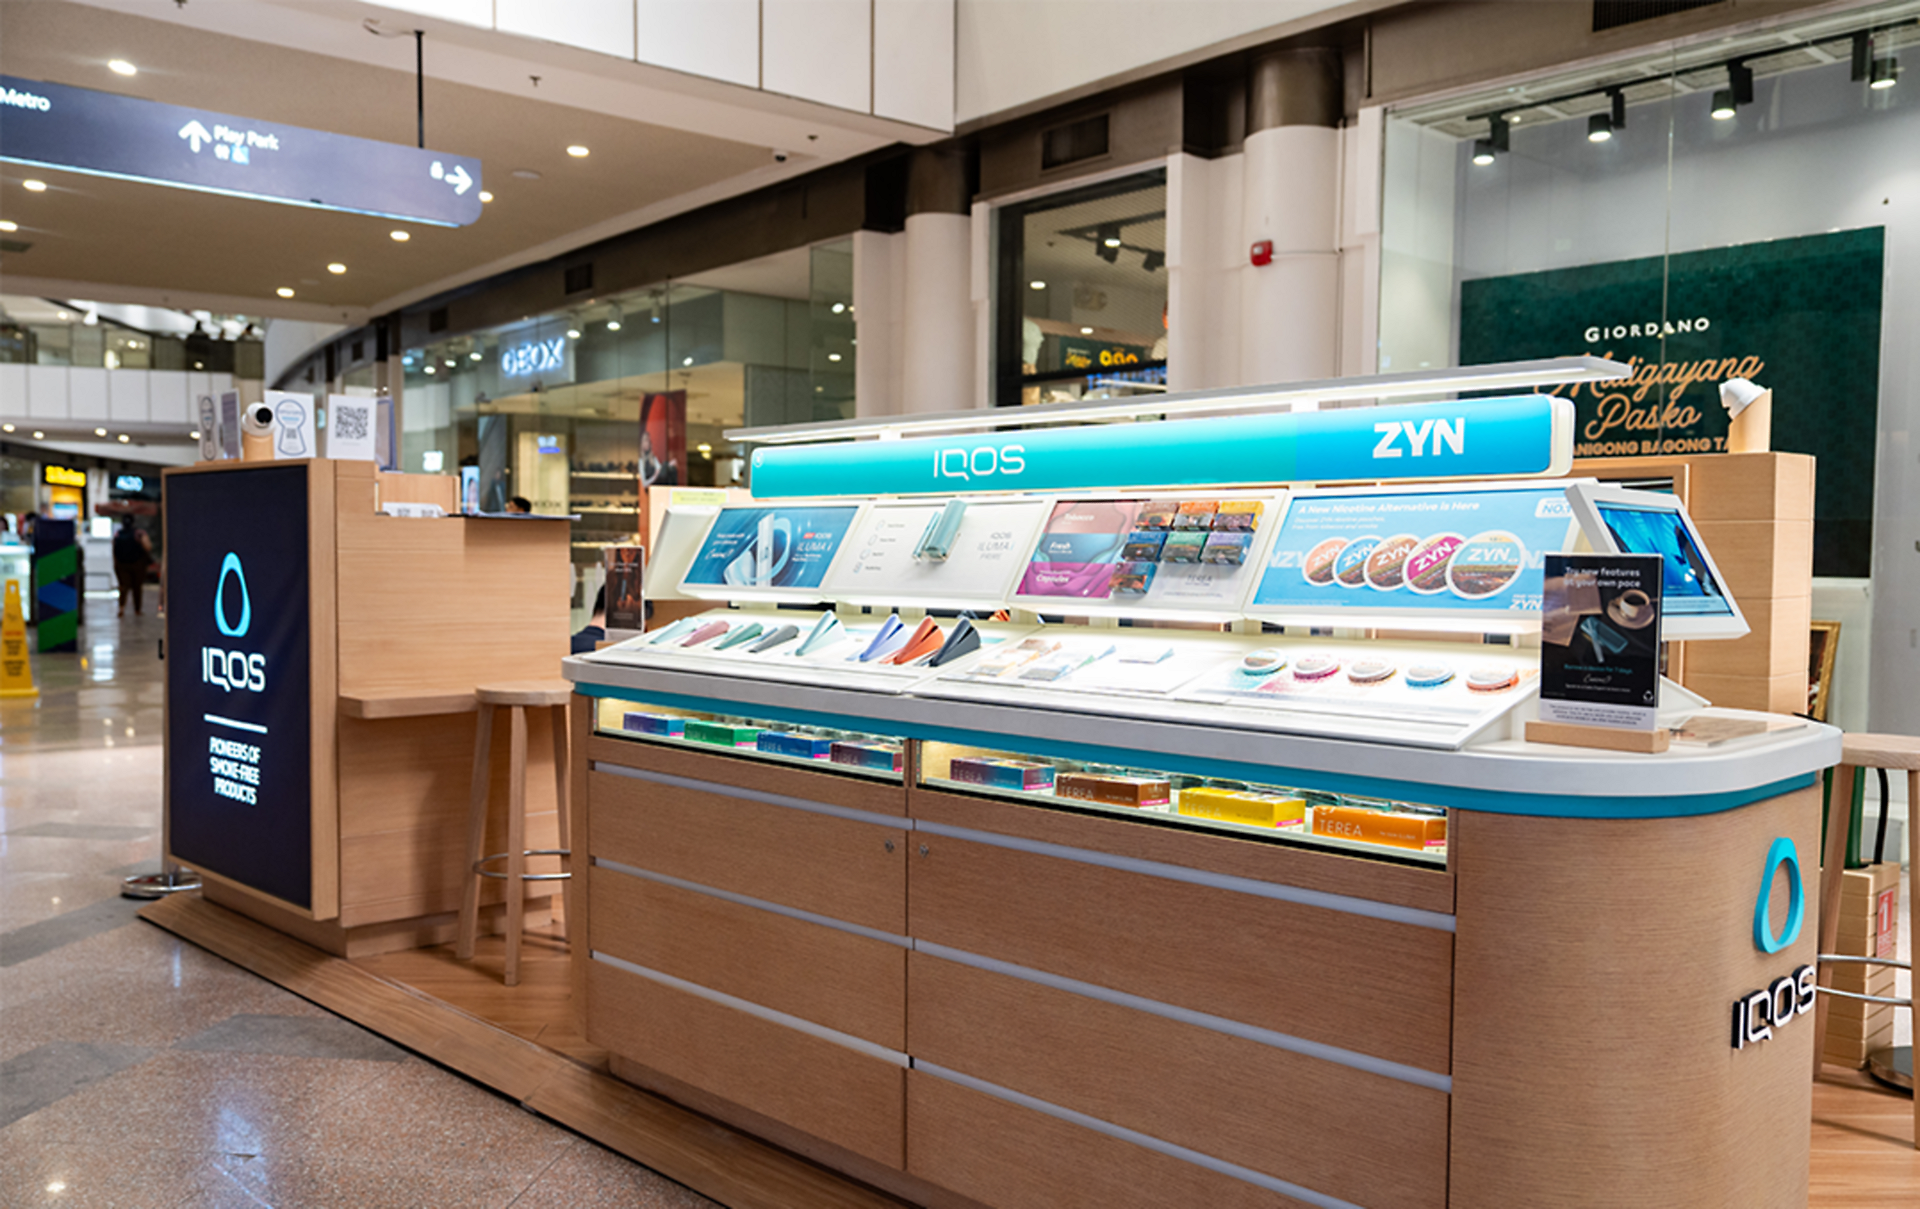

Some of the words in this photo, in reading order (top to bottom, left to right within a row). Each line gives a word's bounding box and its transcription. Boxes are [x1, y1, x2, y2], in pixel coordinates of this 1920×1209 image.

[213, 124, 245, 147] Play
[247, 130, 279, 151] Park
[1584, 317, 1710, 343] GIORDANO
[501, 337, 564, 377] GEOX
[1585, 393, 1703, 440] Pasko
[1373, 417, 1465, 459] ZYN
[1641, 438, 1711, 454] BAGONG
[933, 444, 1026, 482] IQOS
[1308, 506, 1331, 514] New
[1332, 503, 1376, 514] Nicotine
[1377, 501, 1439, 513] Alternative
[1440, 501, 1450, 511] is
[1452, 502, 1480, 511] Here
[1050, 541, 1072, 550] Fresh
[1312, 544, 1340, 567] ZYN
[1342, 543, 1374, 567] ZYN
[1376, 543, 1410, 566] ZYN
[1414, 541, 1453, 571] ZYN
[1466, 547, 1511, 562] ZYN
[1565, 566, 1580, 578] Try
[1581, 568, 1599, 576] new
[1600, 566, 1641, 577] features
[1576, 579, 1597, 588] your
[1617, 580, 1641, 589] pace
[1508, 598, 1542, 611] ZYN
[202, 646, 266, 693] IQOS
[209, 736, 249, 762] PIONEERS
[249, 744, 262, 765] OF
[953, 767, 984, 783] TEREA
[214, 776, 258, 806] PRODUCTS
[1060, 786, 1095, 800] TEREA
[1184, 802, 1222, 818] TEREA
[1318, 819, 1363, 837] TEREA
[1731, 964, 1816, 1050] IQOS
